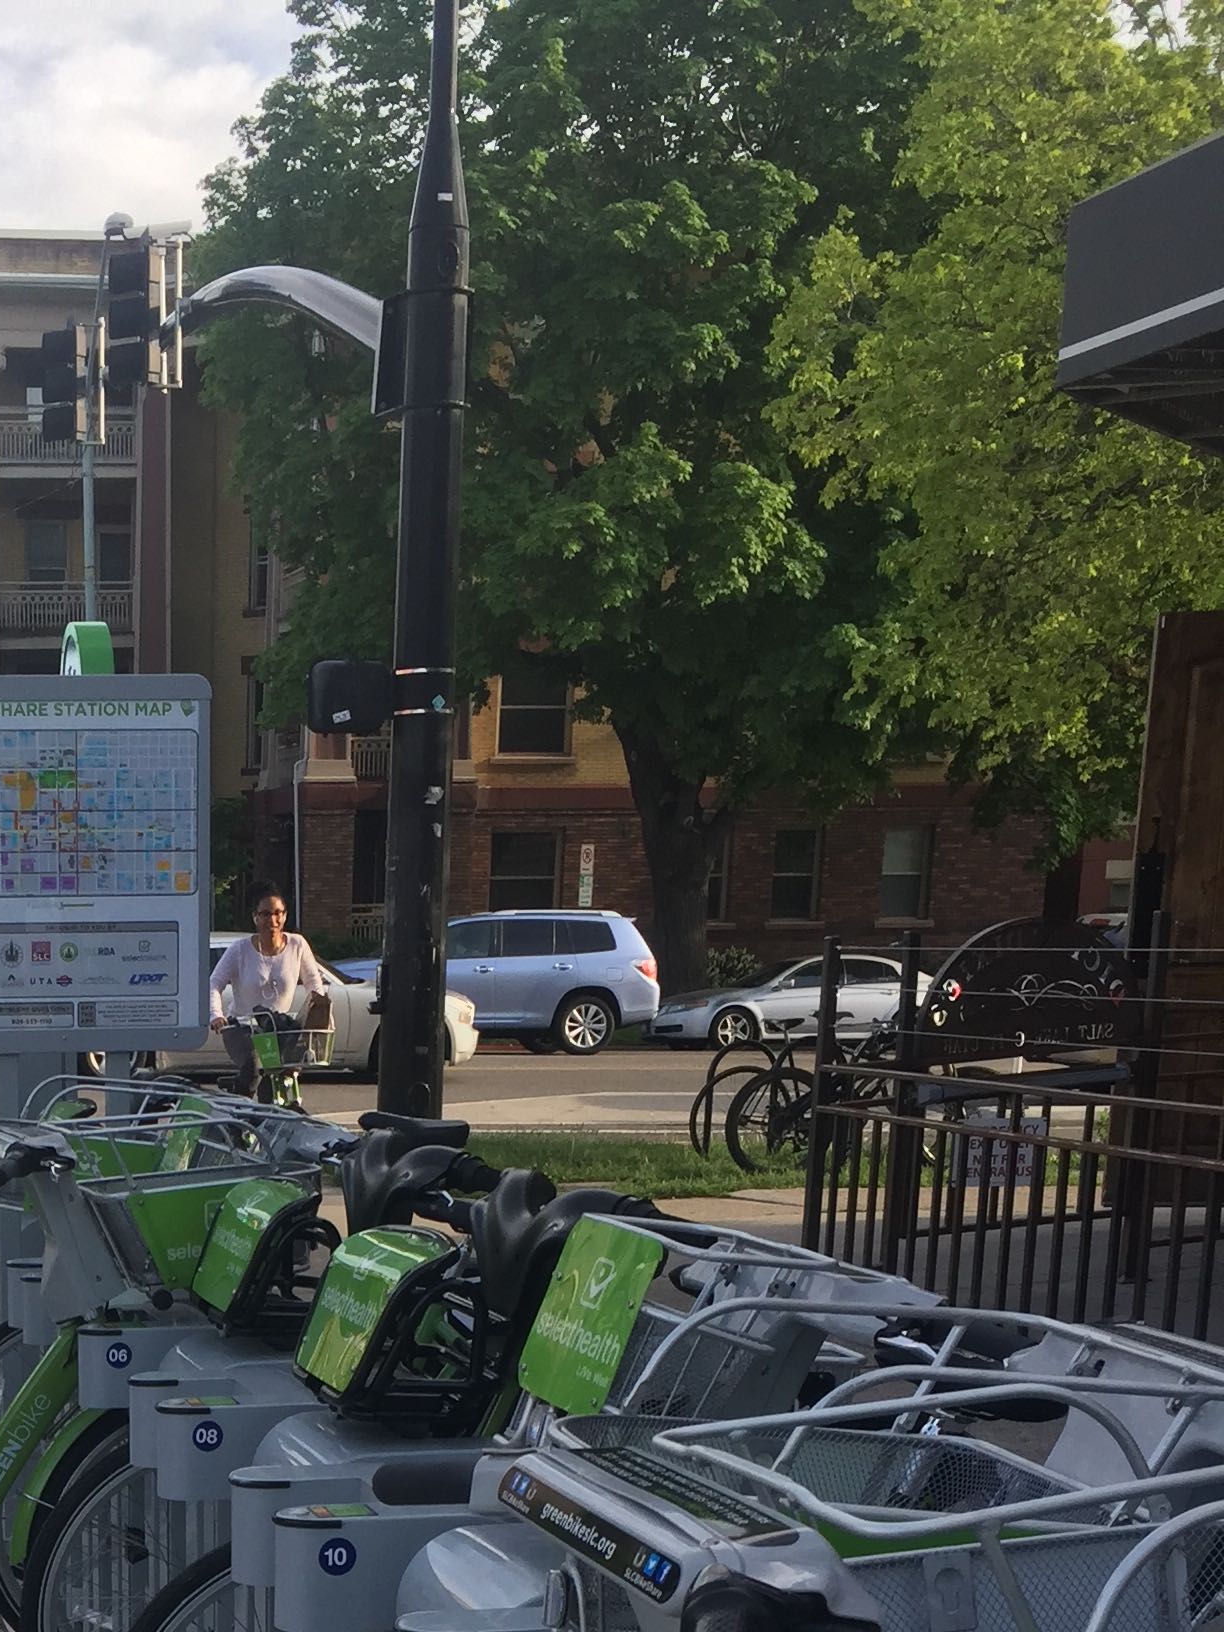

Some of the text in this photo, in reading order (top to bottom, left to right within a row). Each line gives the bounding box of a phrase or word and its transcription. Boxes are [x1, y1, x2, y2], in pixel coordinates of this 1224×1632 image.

[54, 702, 129, 716] STATION
[134, 702, 172, 716] MAP
[33, 952, 50, 961] SLC
[973, 1154, 999, 1166] NT
[536, 1310, 622, 1368] selecthealth
[109, 1348, 128, 1362] 06
[196, 1428, 218, 1444] 08
[540, 1502, 617, 1560] greenbikeslc.org
[324, 1547, 347, 1566] 10
